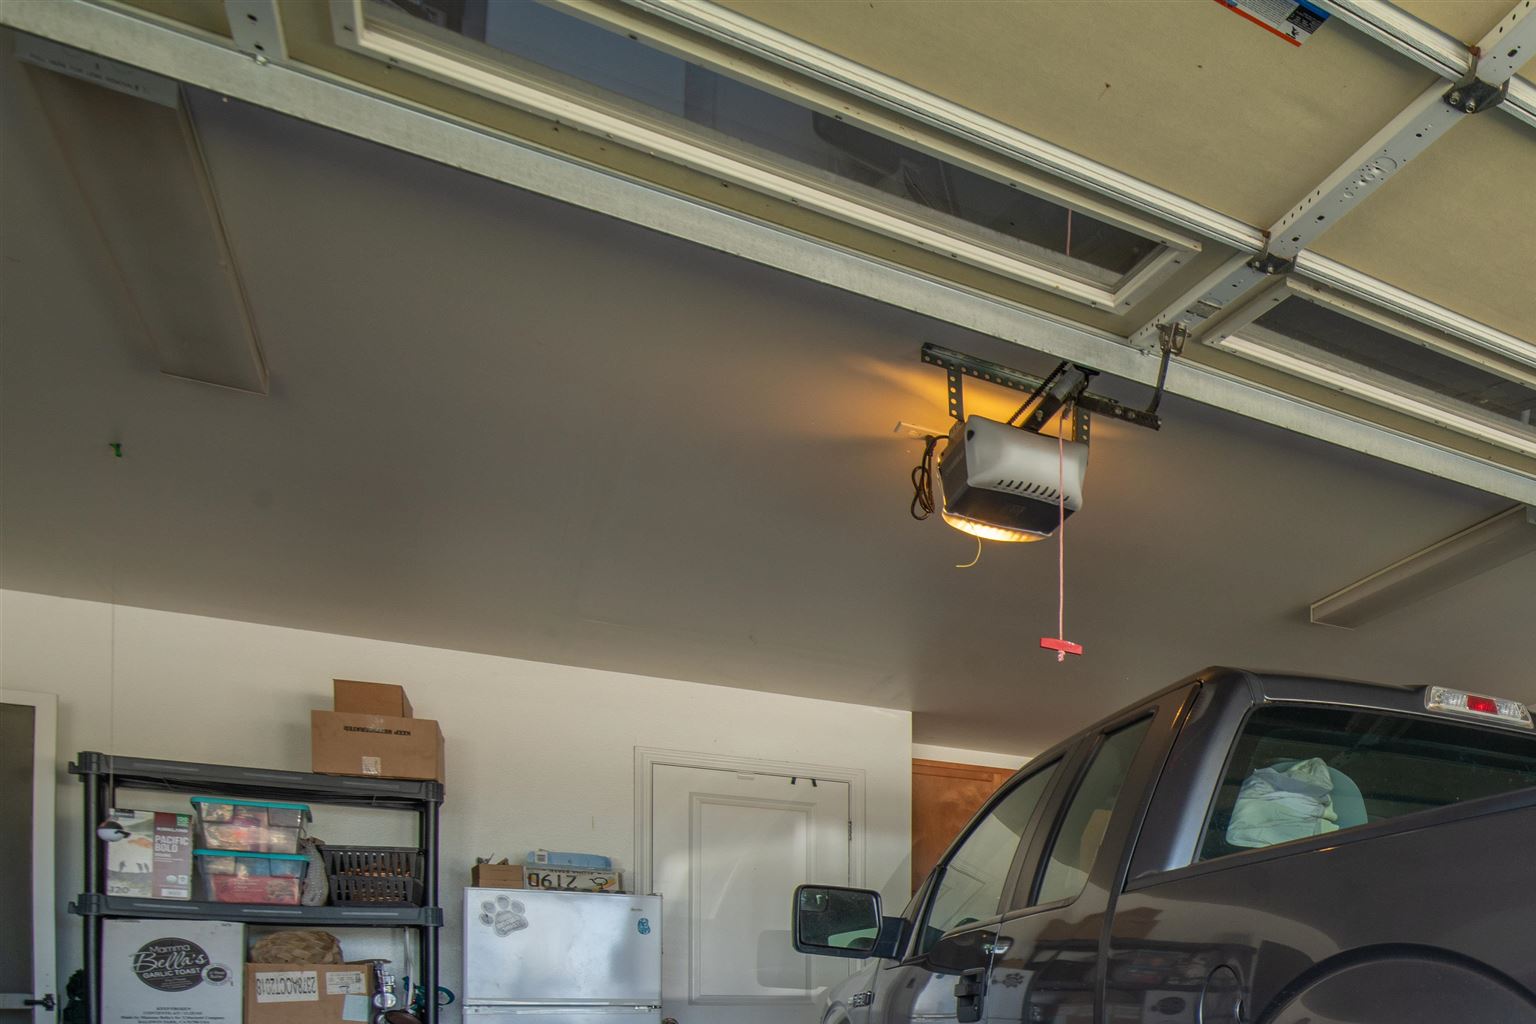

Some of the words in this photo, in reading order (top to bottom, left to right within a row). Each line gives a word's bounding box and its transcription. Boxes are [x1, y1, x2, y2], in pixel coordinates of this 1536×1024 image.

[154, 835, 190, 846] PACIFIC
[154, 843, 179, 853] BOLD
[149, 944, 191, 954] Mamma
[129, 951, 208, 973] Bella's
[142, 970, 173, 979] GARLIC
[175, 967, 201, 977] TOAST
